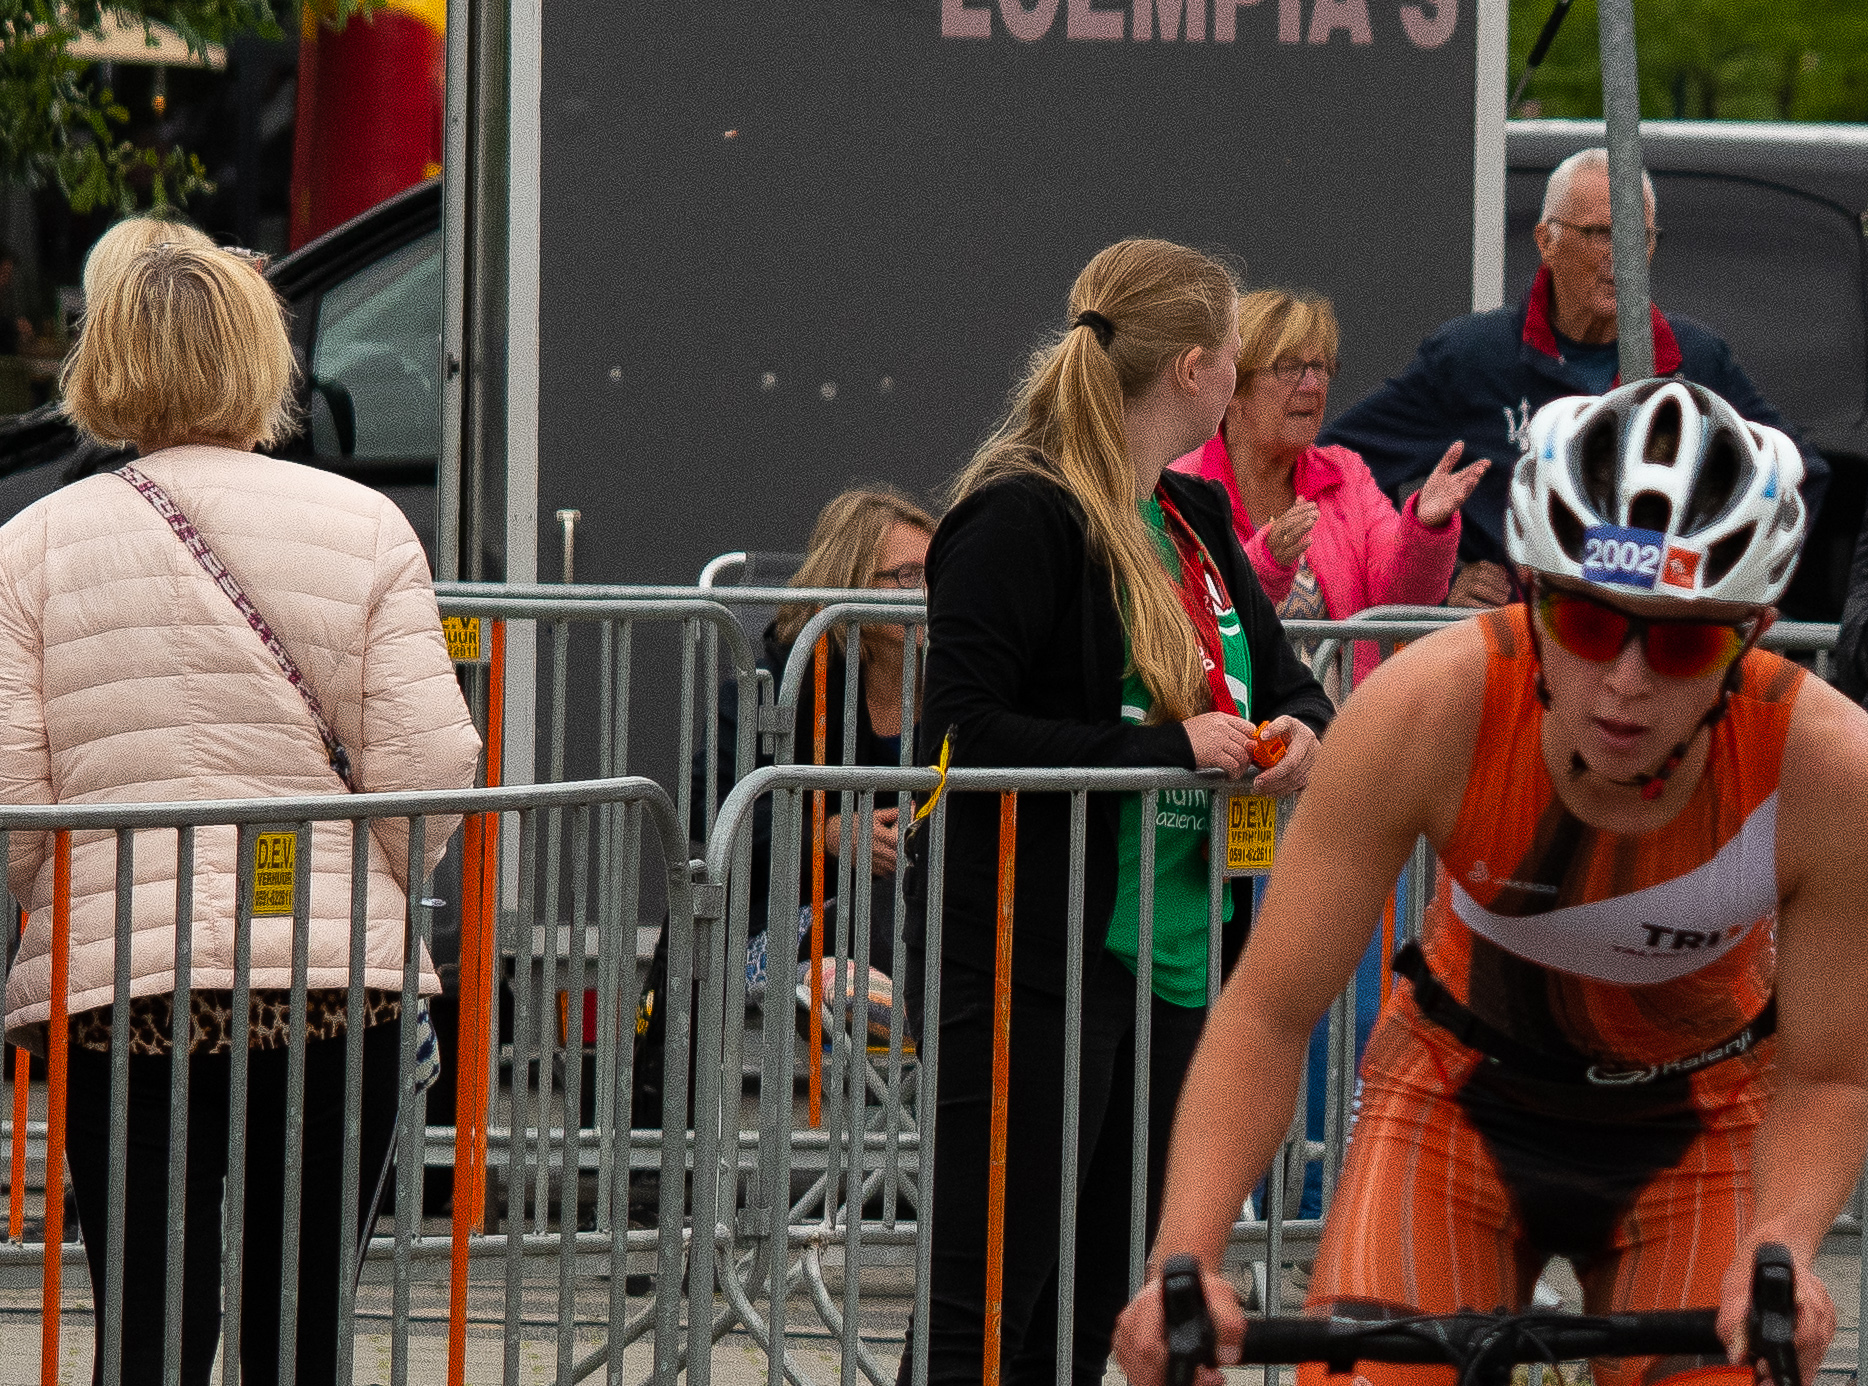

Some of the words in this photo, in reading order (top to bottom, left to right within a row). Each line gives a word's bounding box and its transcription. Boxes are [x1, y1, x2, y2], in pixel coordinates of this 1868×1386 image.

[1585, 537, 1661, 575] 2002
[1231, 800, 1273, 828] D.E.V.
[257, 838, 294, 869] D.E.V.
[1641, 921, 1720, 950] TRI
